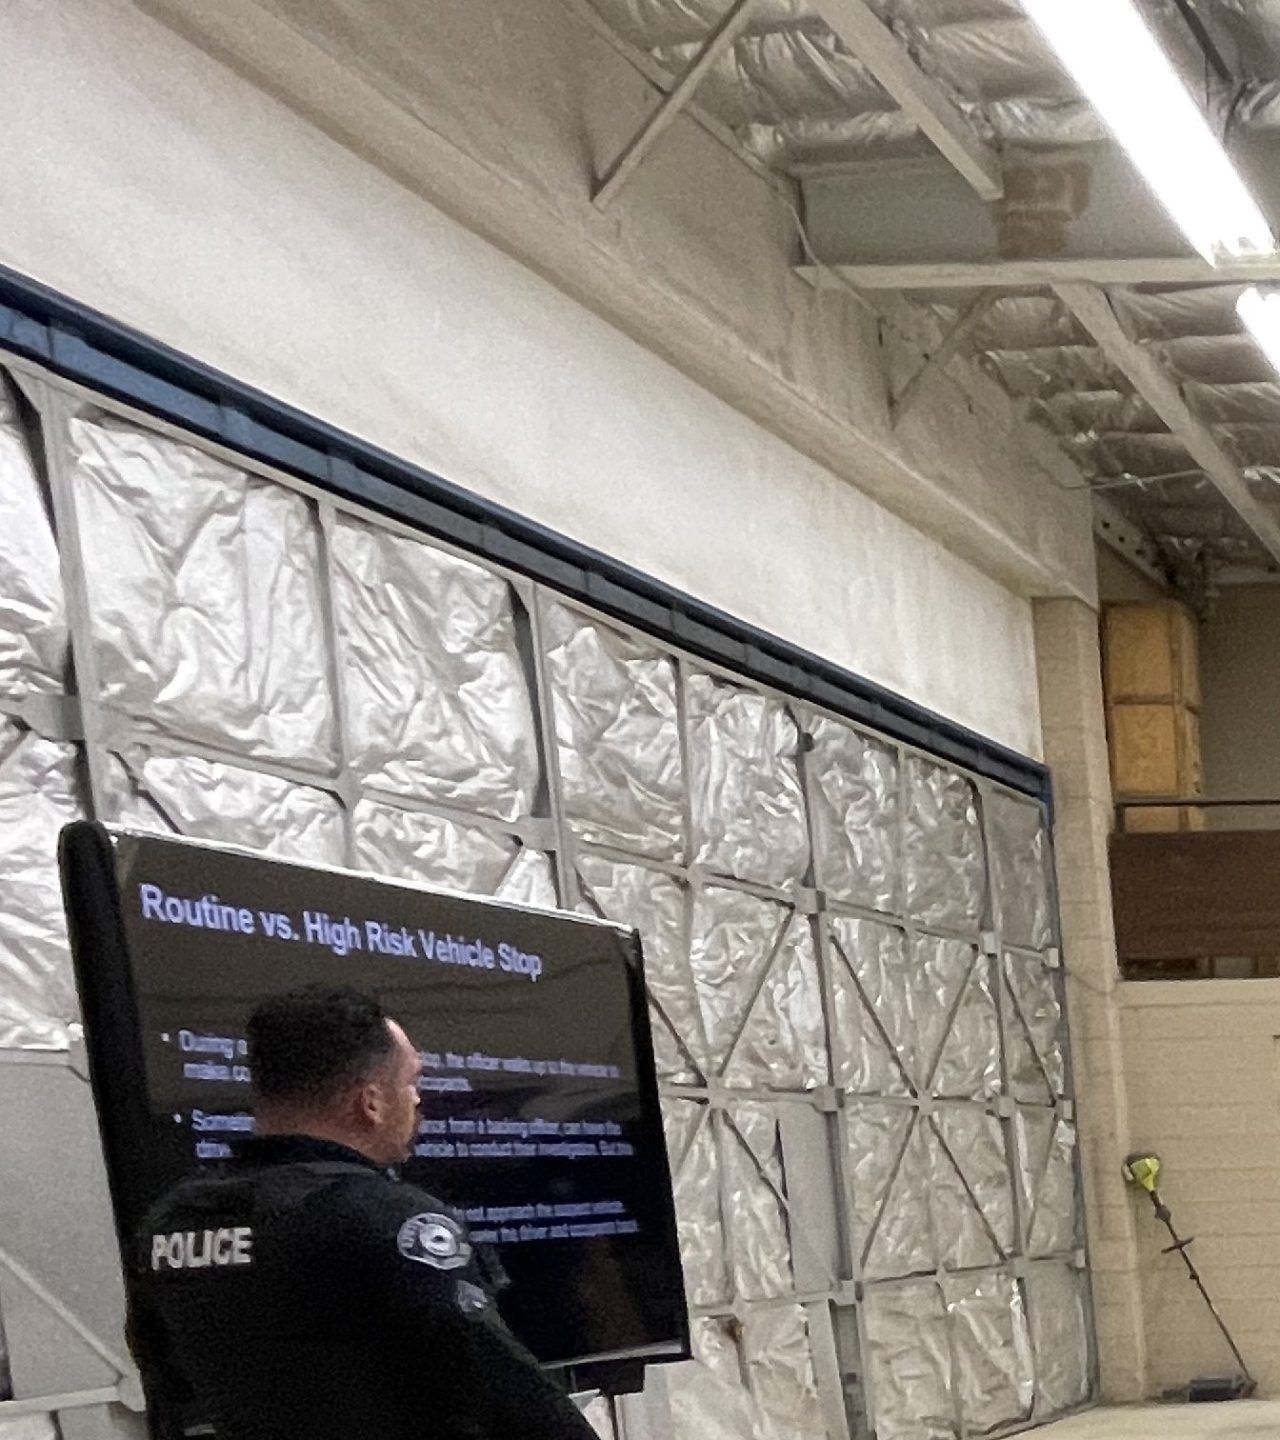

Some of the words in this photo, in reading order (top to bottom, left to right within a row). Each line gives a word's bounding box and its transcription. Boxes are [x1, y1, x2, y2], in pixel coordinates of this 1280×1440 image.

[139, 882, 256, 934] Routine
[258, 910, 300, 941] vs.
[302, 910, 362, 957] High
[364, 920, 418, 958] Risk
[417, 928, 496, 970] Vehicle
[498, 942, 543, 983] Stop
[151, 1227, 253, 1271] POLICE
